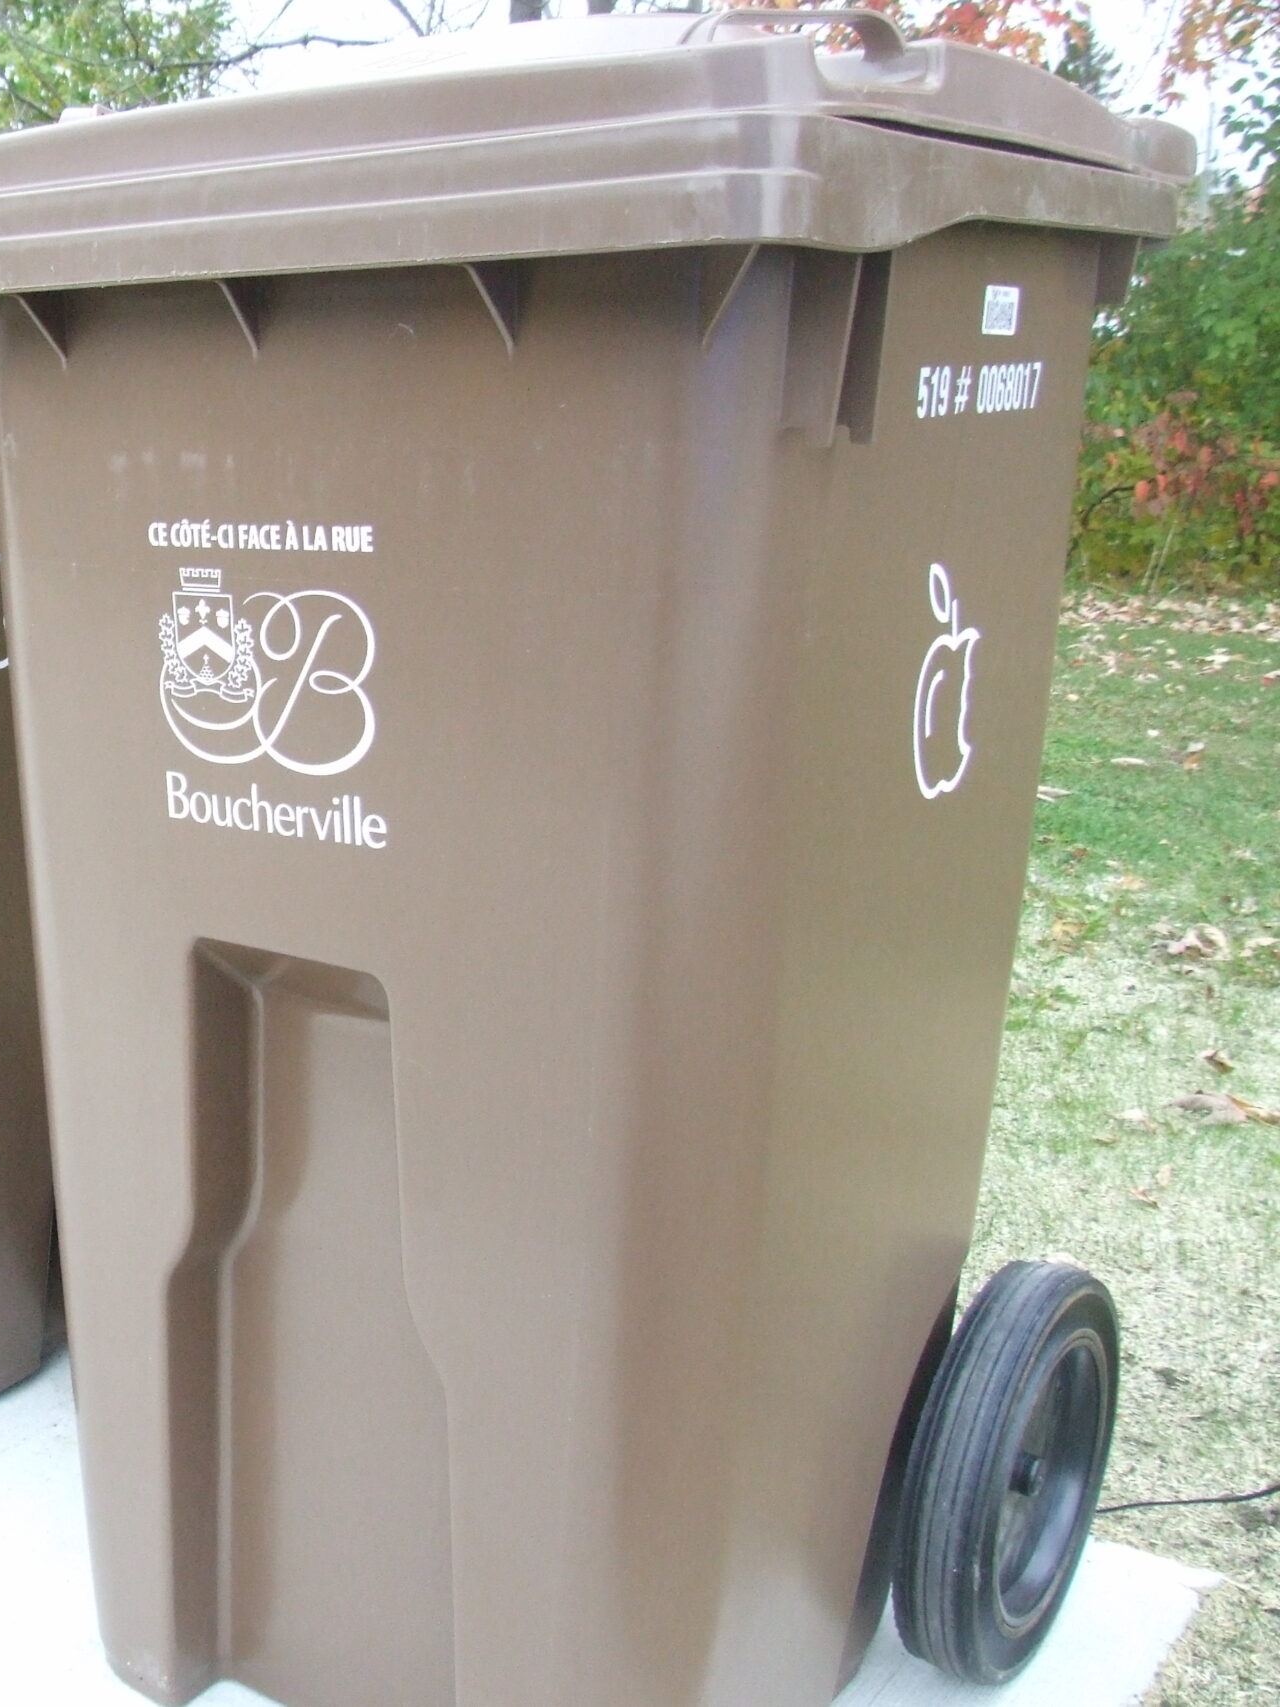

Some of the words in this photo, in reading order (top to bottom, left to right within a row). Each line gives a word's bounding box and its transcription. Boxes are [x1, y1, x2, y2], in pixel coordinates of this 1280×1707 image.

[917, 366, 951, 419] 519
[954, 365, 972, 415] #
[977, 361, 1042, 414] 0068017
[148, 522, 168, 547] CE
[170, 518, 234, 549] CÔTÉ-CI
[238, 524, 281, 550] FACE
[285, 520, 299, 551] À
[302, 525, 328, 551] LA
[332, 526, 374, 553] RUE
[166, 770, 388, 850] Boucherville
